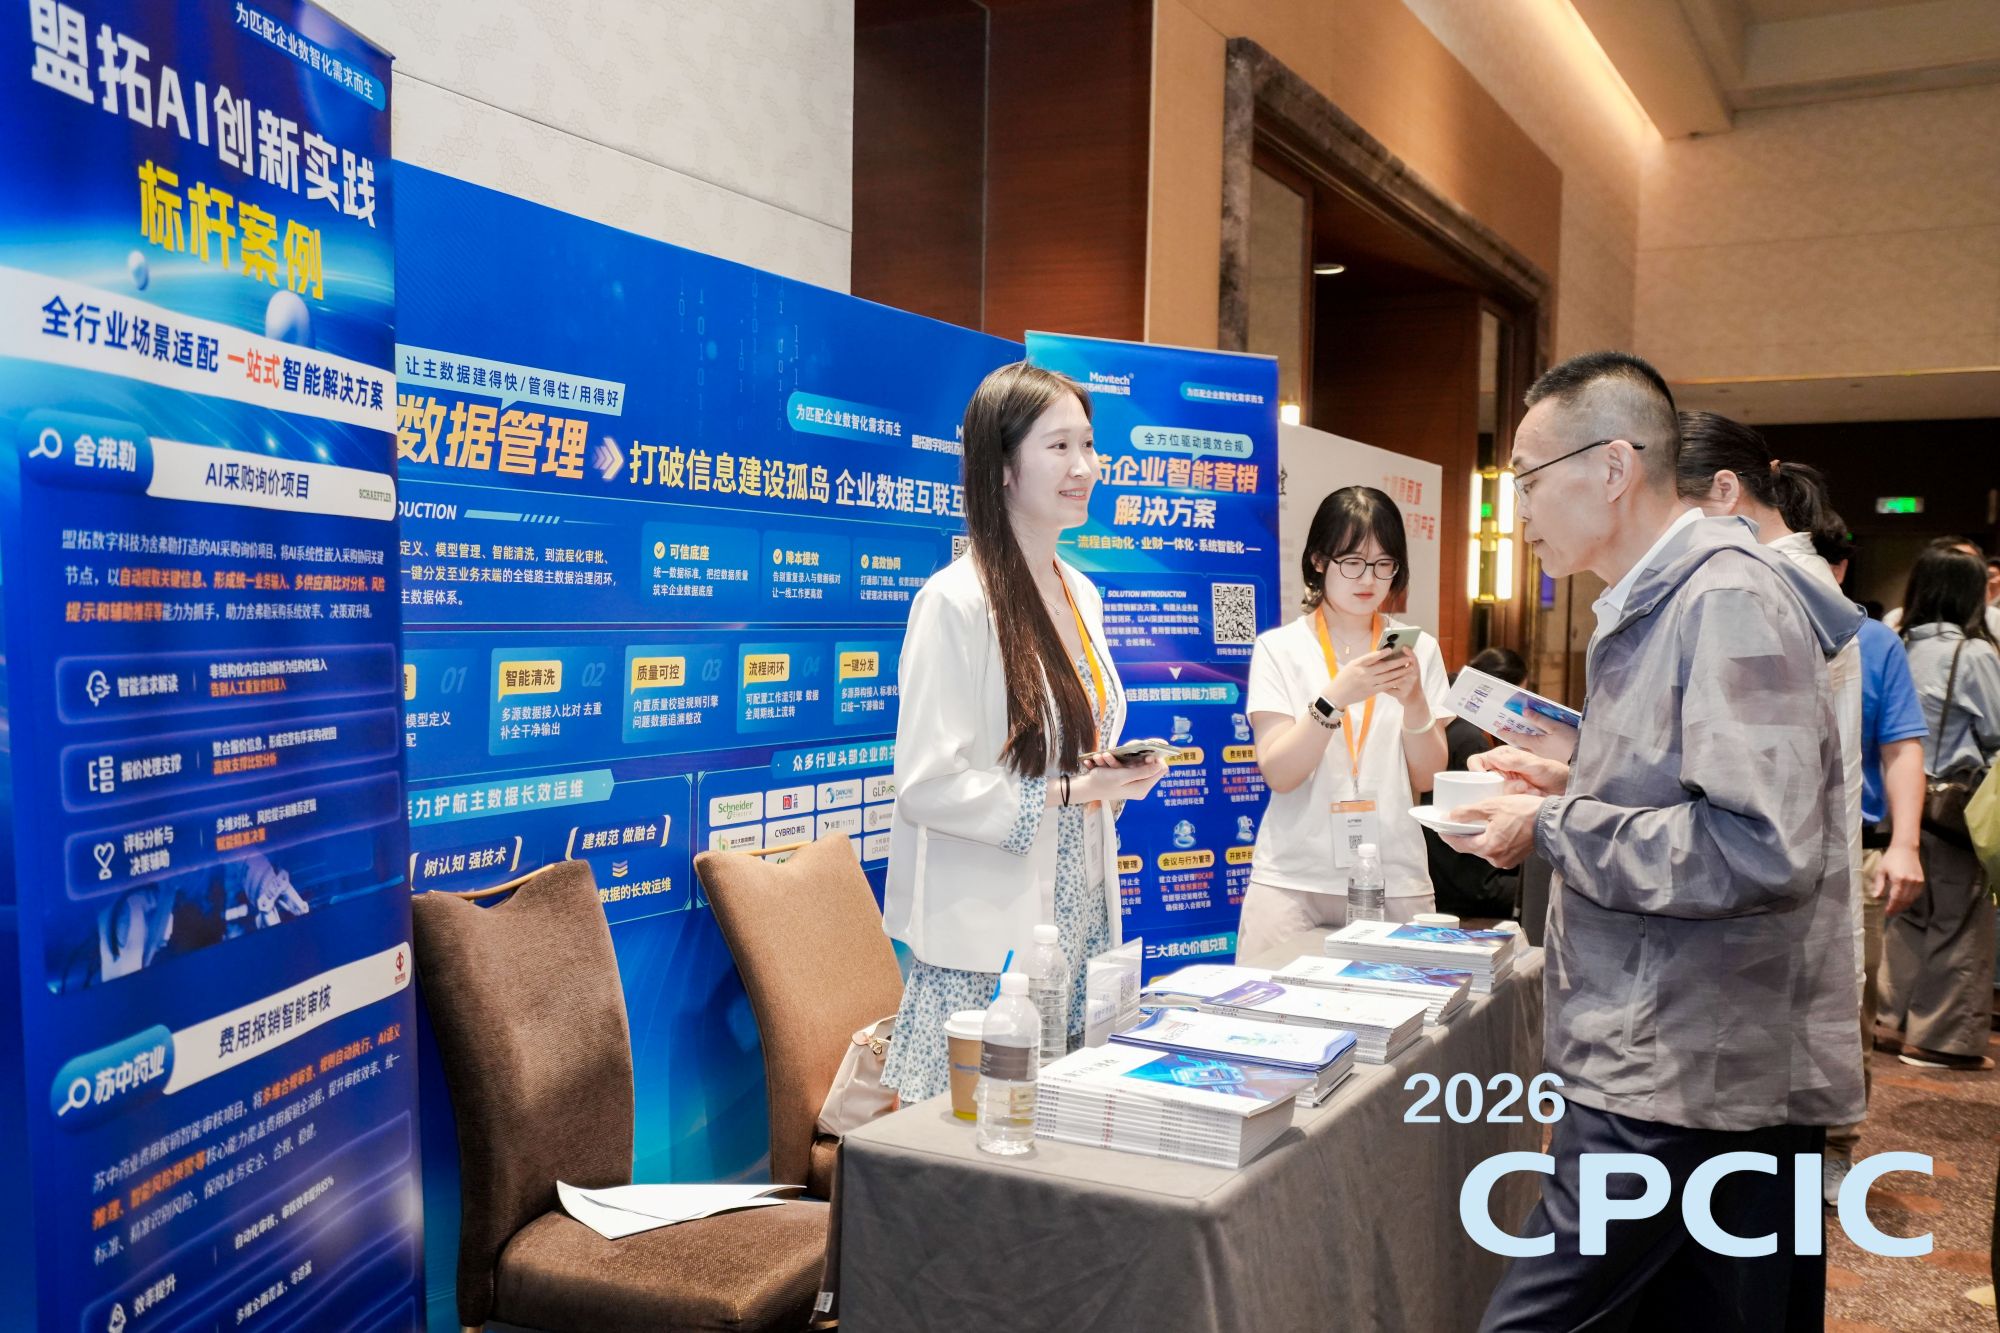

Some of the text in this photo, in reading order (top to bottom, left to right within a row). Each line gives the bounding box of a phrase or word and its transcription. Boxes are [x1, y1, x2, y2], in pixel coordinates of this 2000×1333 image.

[236, 1, 375, 101] 为匹配企业数智化需求而生
[29, 0, 376, 228] 盟拓AI创新实践
[138, 159, 325, 300] 标杆案例
[41, 295, 384, 412] 全行业场景适配 一站式智能解决方案
[405, 355, 619, 408] 让主数据建得快/管得住/用得好
[795, 403, 902, 437] 为匹配企业数智化需求而生
[397, 393, 589, 481] 数据管理
[1144, 432, 1244, 453] 全方位驱动提效合规
[74, 434, 137, 473] 舍弗勒
[205, 462, 310, 499] AI采购询价项目
[629, 440, 831, 504] 打破信息建设孤岛
[1113, 494, 1217, 529] 解决方案
[670, 543, 710, 561] 可信底座
[785, 550, 819, 567] 降本提效
[652, 584, 713, 597] 筑牢企业数据底座
[772, 588, 823, 600] 让一线工作更高效
[581, 662, 607, 688] 02
[636, 664, 680, 681] 质量可控
[702, 659, 722, 682] 03
[749, 661, 785, 676] 流程闭环
[844, 658, 875, 672] 一键分发
[440, 666, 468, 694] 01
[505, 668, 556, 688] 智能清洗
[633, 695, 719, 712] 内置质量校验规则引擎
[805, 689, 819, 702] 数据
[405, 711, 451, 729] 模型定义
[501, 702, 603, 722] 多源数据接入比对 去重
[500, 722, 561, 740] 补全干净输出
[718, 800, 754, 814] Schneider
[581, 824, 657, 850] 建规范 做融合
[423, 847, 507, 878] 树认知 强技术
[1163, 854, 1211, 867] 会议与行为管理
[1145, 937, 1228, 959] 三大核心价值兑现
[219, 984, 332, 1058] 费用报销智能审核
[94, 1045, 167, 1106] 苏中药业
